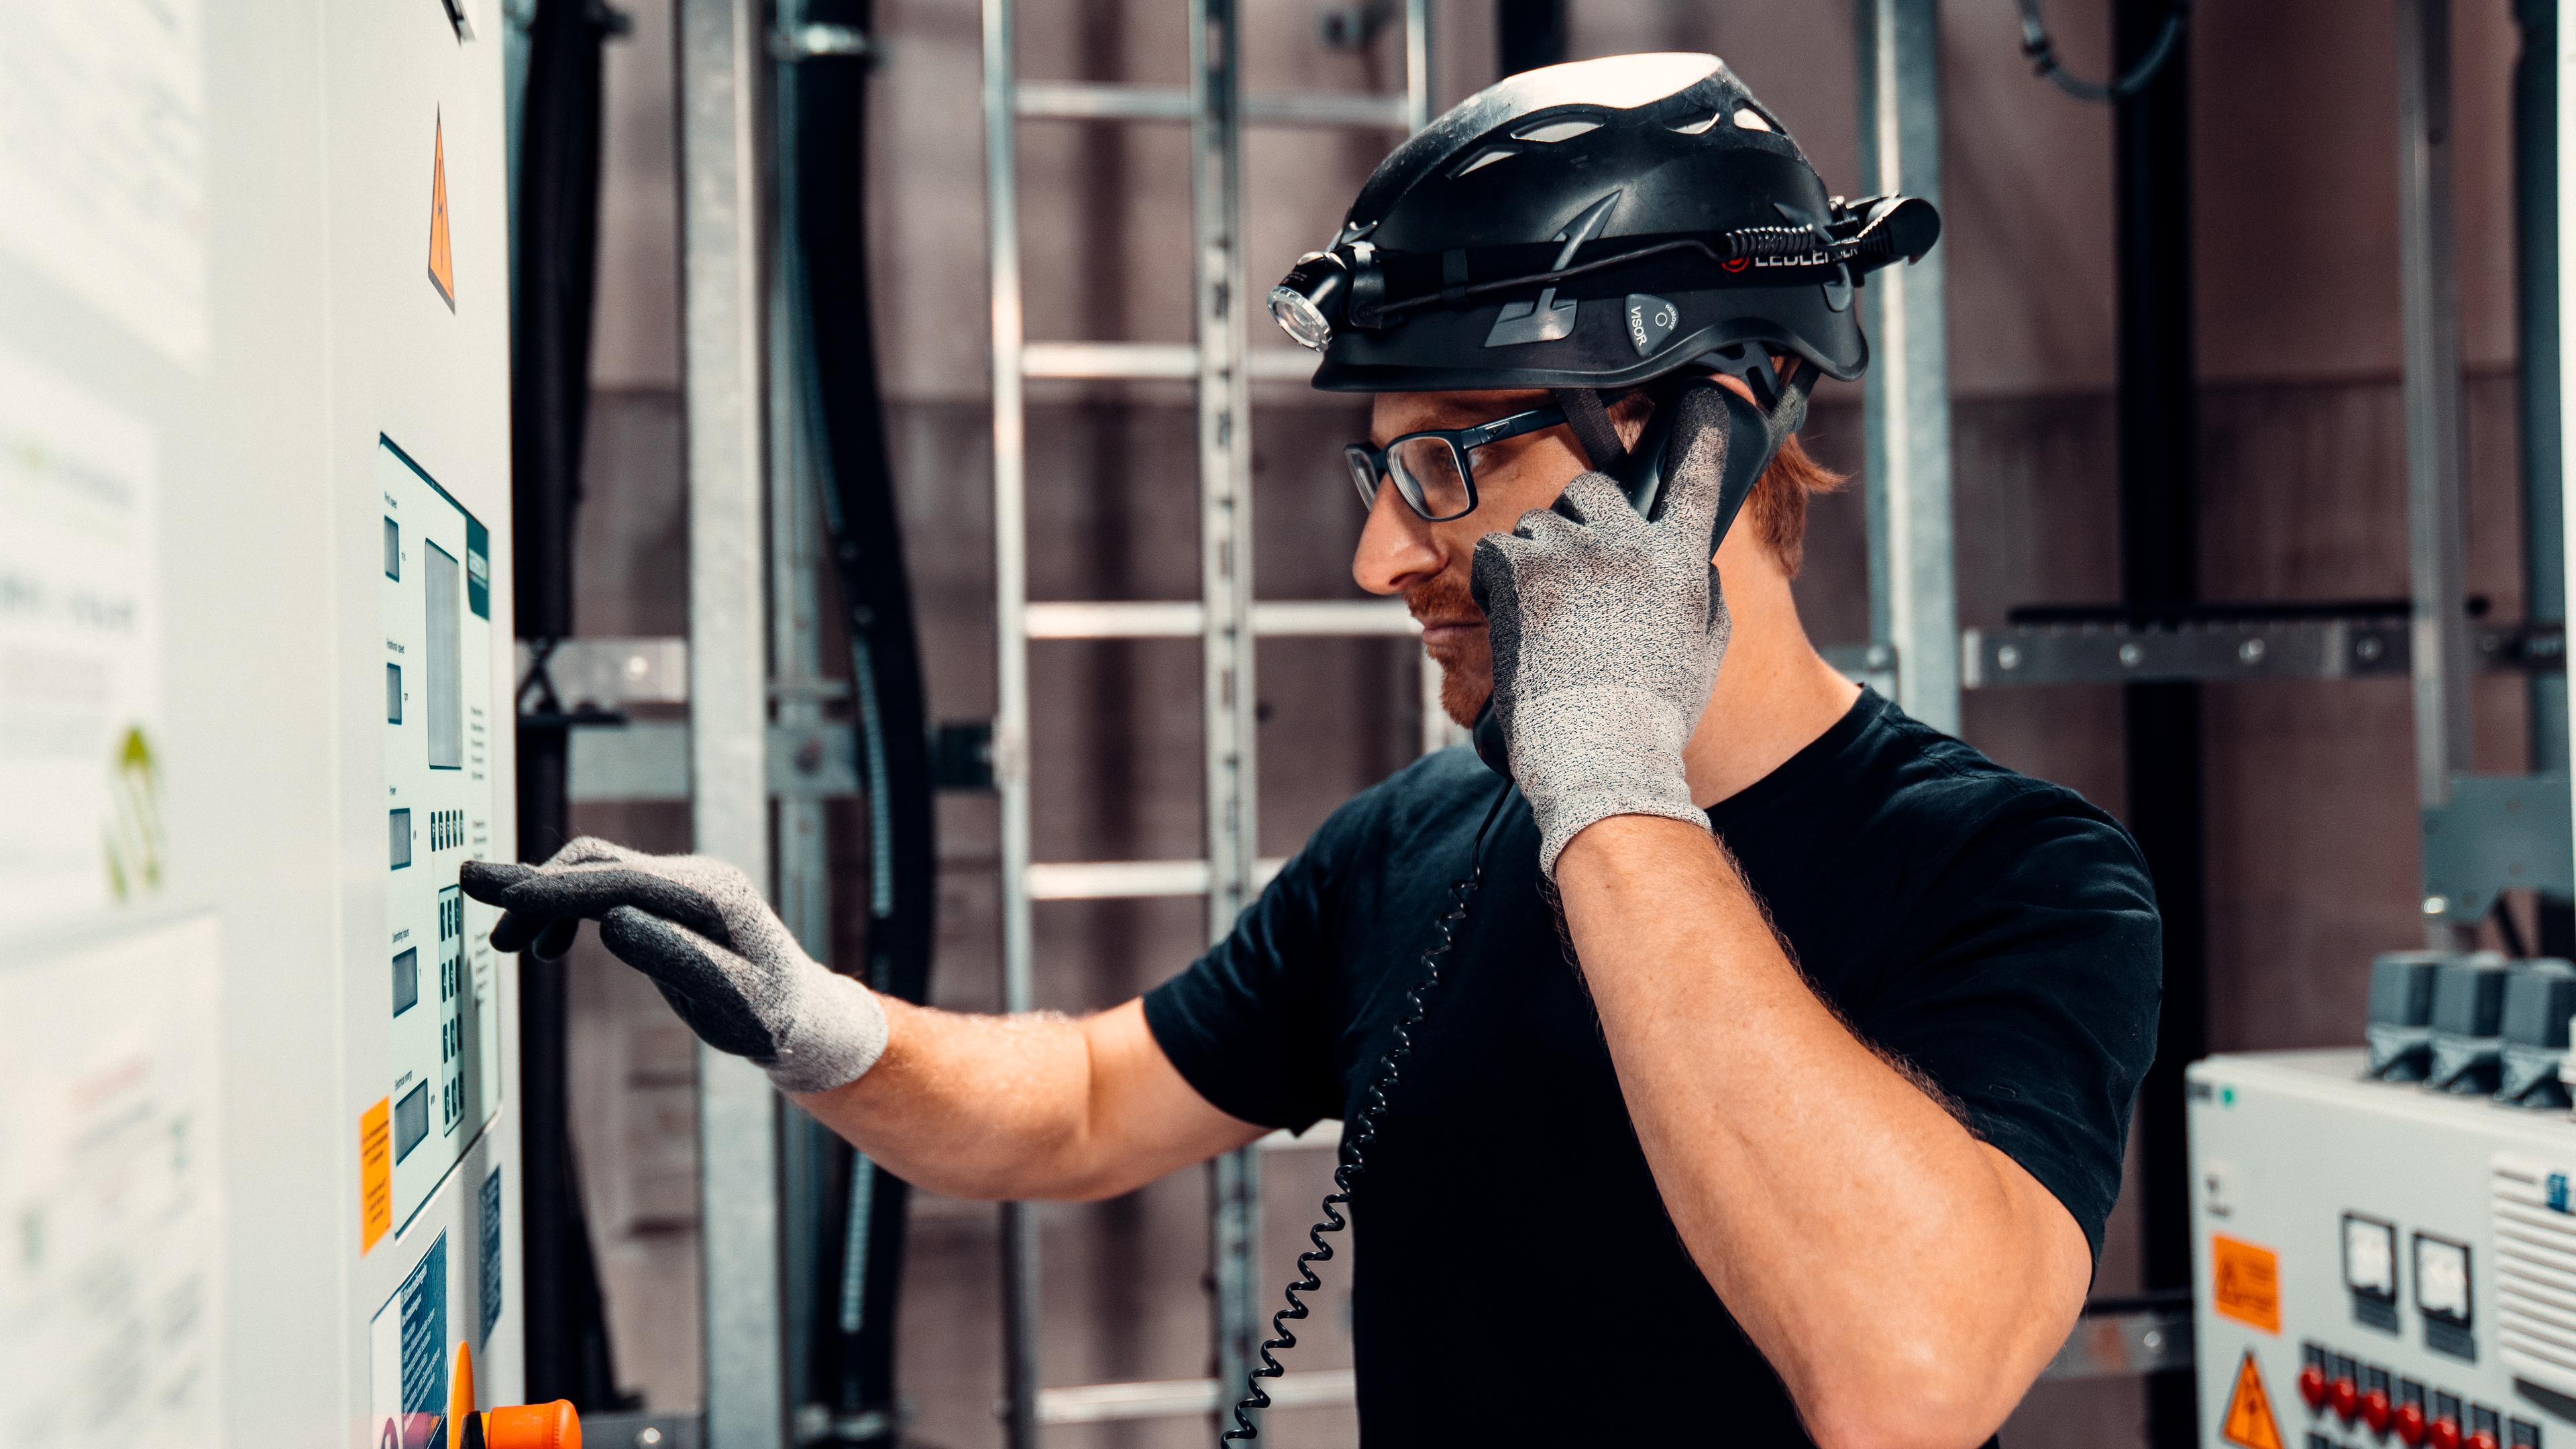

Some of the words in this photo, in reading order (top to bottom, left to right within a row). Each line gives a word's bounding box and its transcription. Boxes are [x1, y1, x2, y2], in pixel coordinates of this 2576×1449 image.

[1755, 248, 1858, 267] LEDLE
[1631, 305, 1648, 347] VISOR
[1664, 303, 1676, 331] REMOVE
